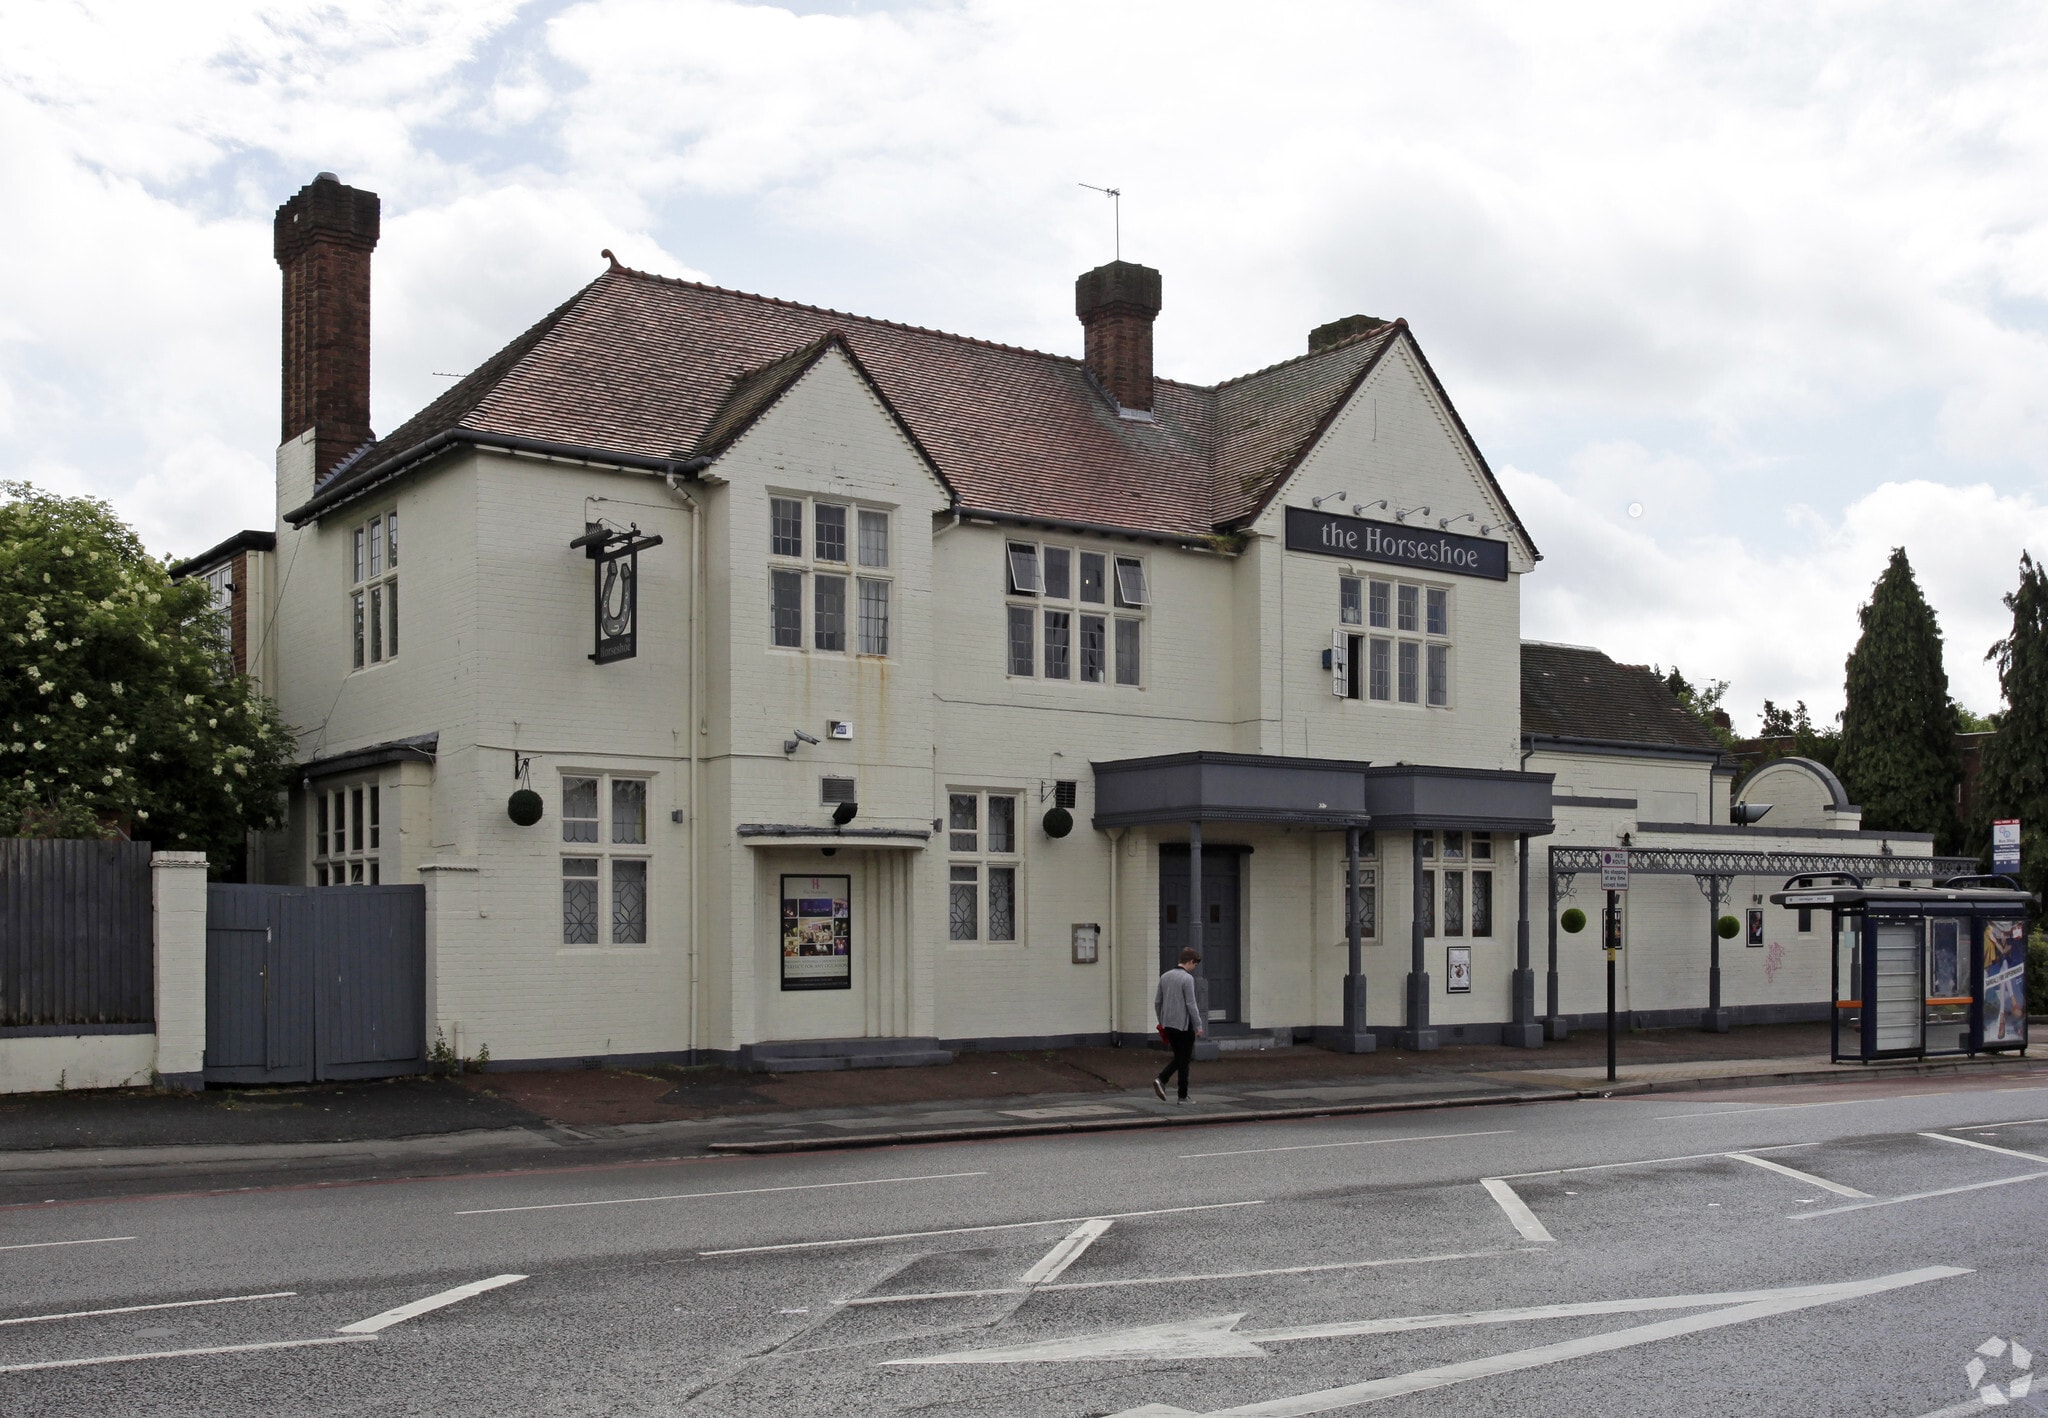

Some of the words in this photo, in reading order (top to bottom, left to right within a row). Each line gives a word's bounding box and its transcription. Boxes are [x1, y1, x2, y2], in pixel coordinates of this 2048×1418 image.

[1321, 522, 1358, 549] the
[1365, 527, 1479, 568] Horseshoe
[600, 643, 631, 657] Horseshoe
